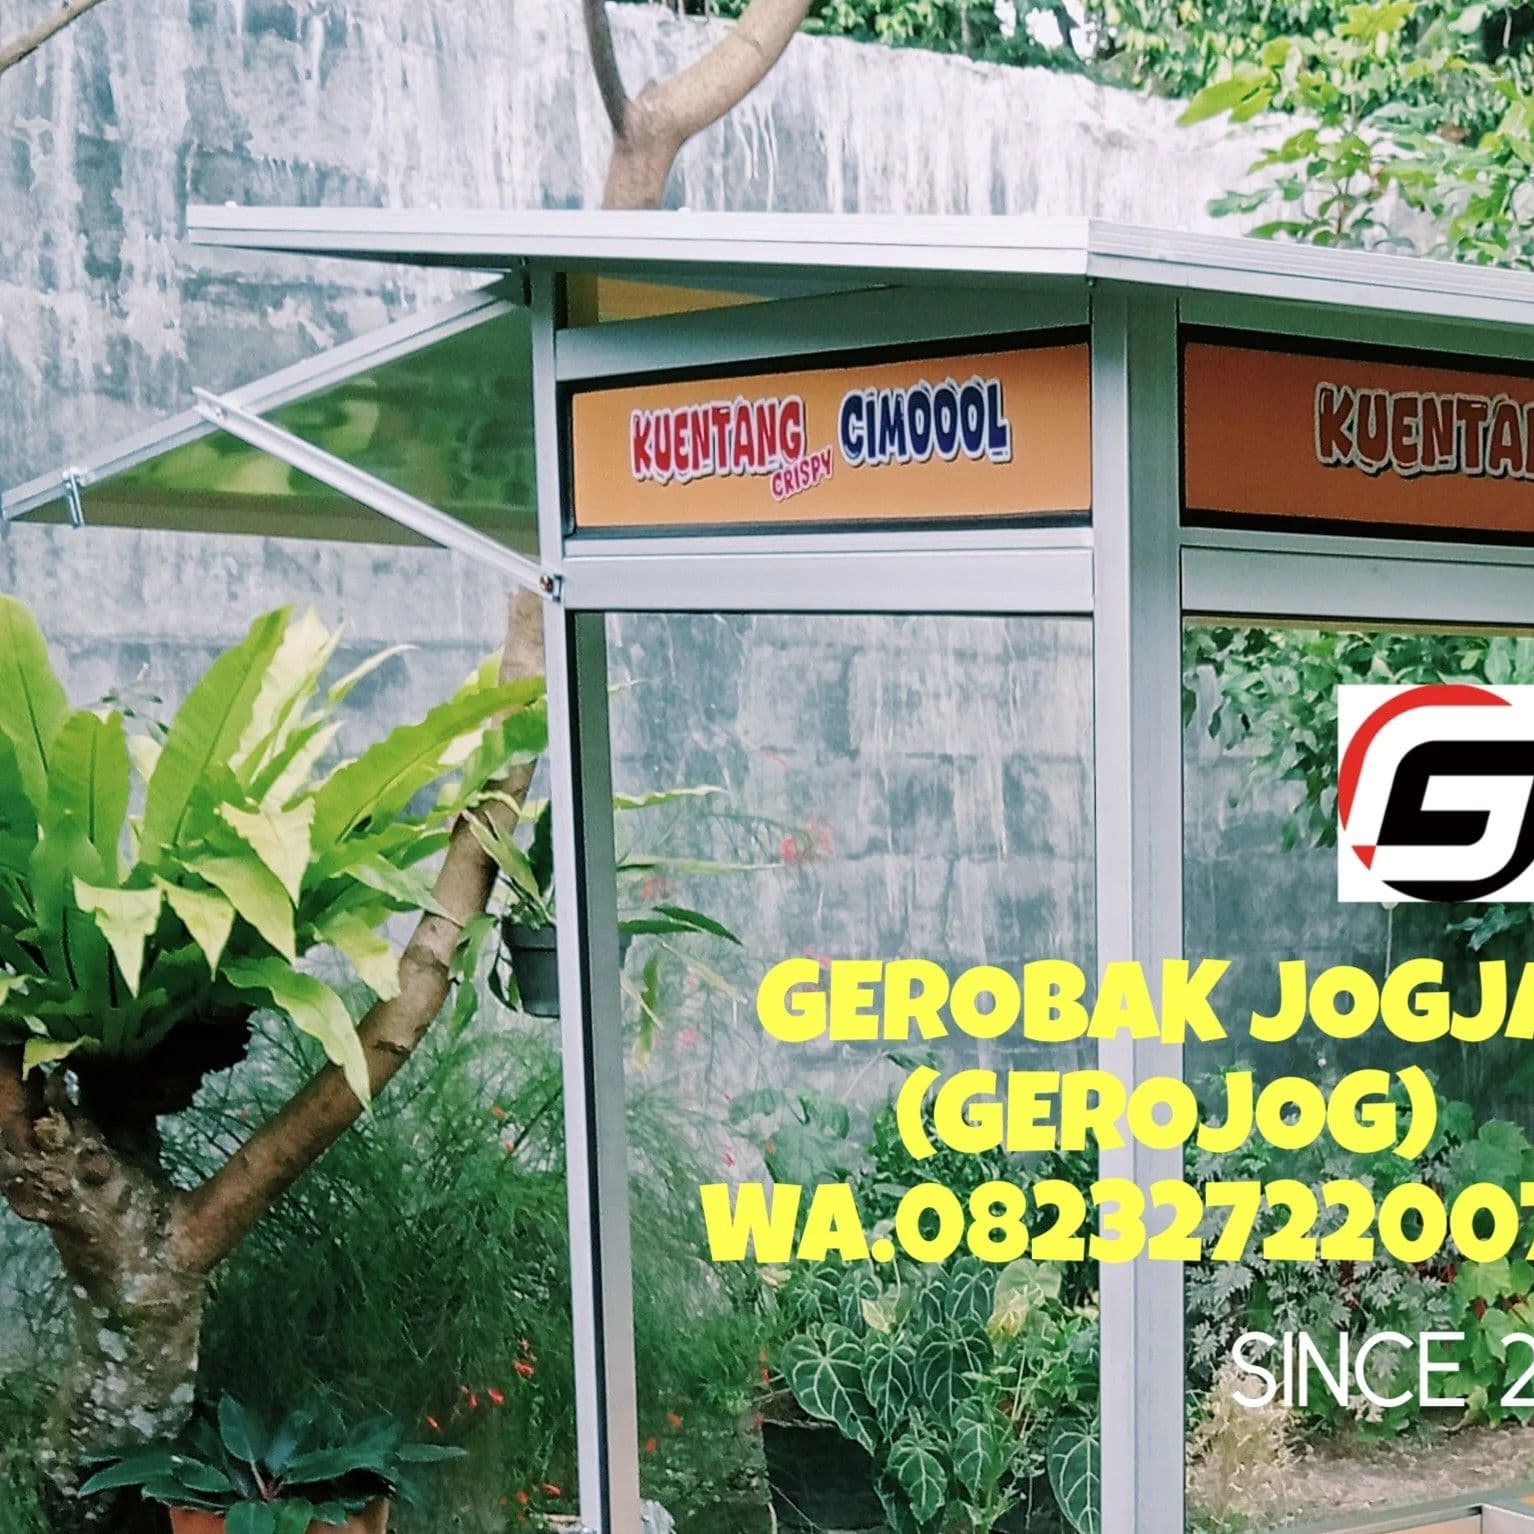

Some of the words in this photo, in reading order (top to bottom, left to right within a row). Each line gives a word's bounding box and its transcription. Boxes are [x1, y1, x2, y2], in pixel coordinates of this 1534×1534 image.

[632, 399, 803, 478] KUENTANG
[840, 386, 1009, 461] CIMOOOL
[770, 450, 833, 497] CRISPY
